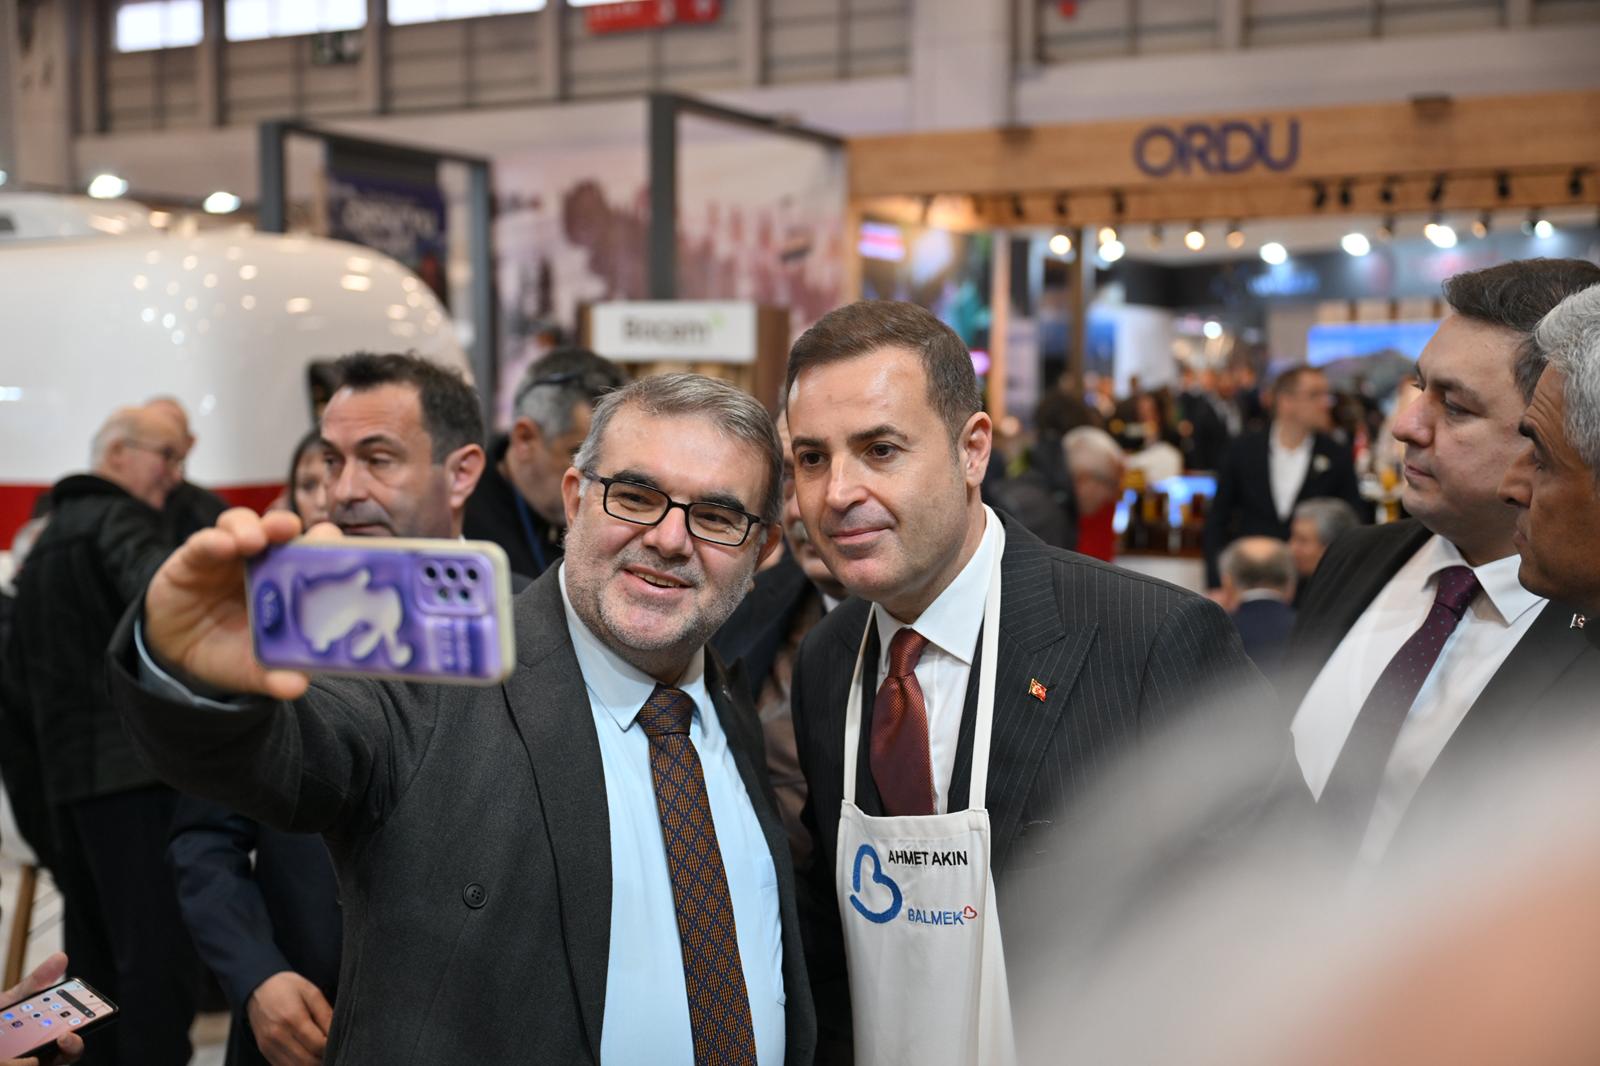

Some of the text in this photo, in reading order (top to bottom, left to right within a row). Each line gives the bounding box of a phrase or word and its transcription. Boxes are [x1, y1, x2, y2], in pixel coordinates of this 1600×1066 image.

[1132, 117, 1301, 177] ORDU
[888, 850, 968, 866] AHMET AKIN
[908, 908, 964, 925] BALMEK
